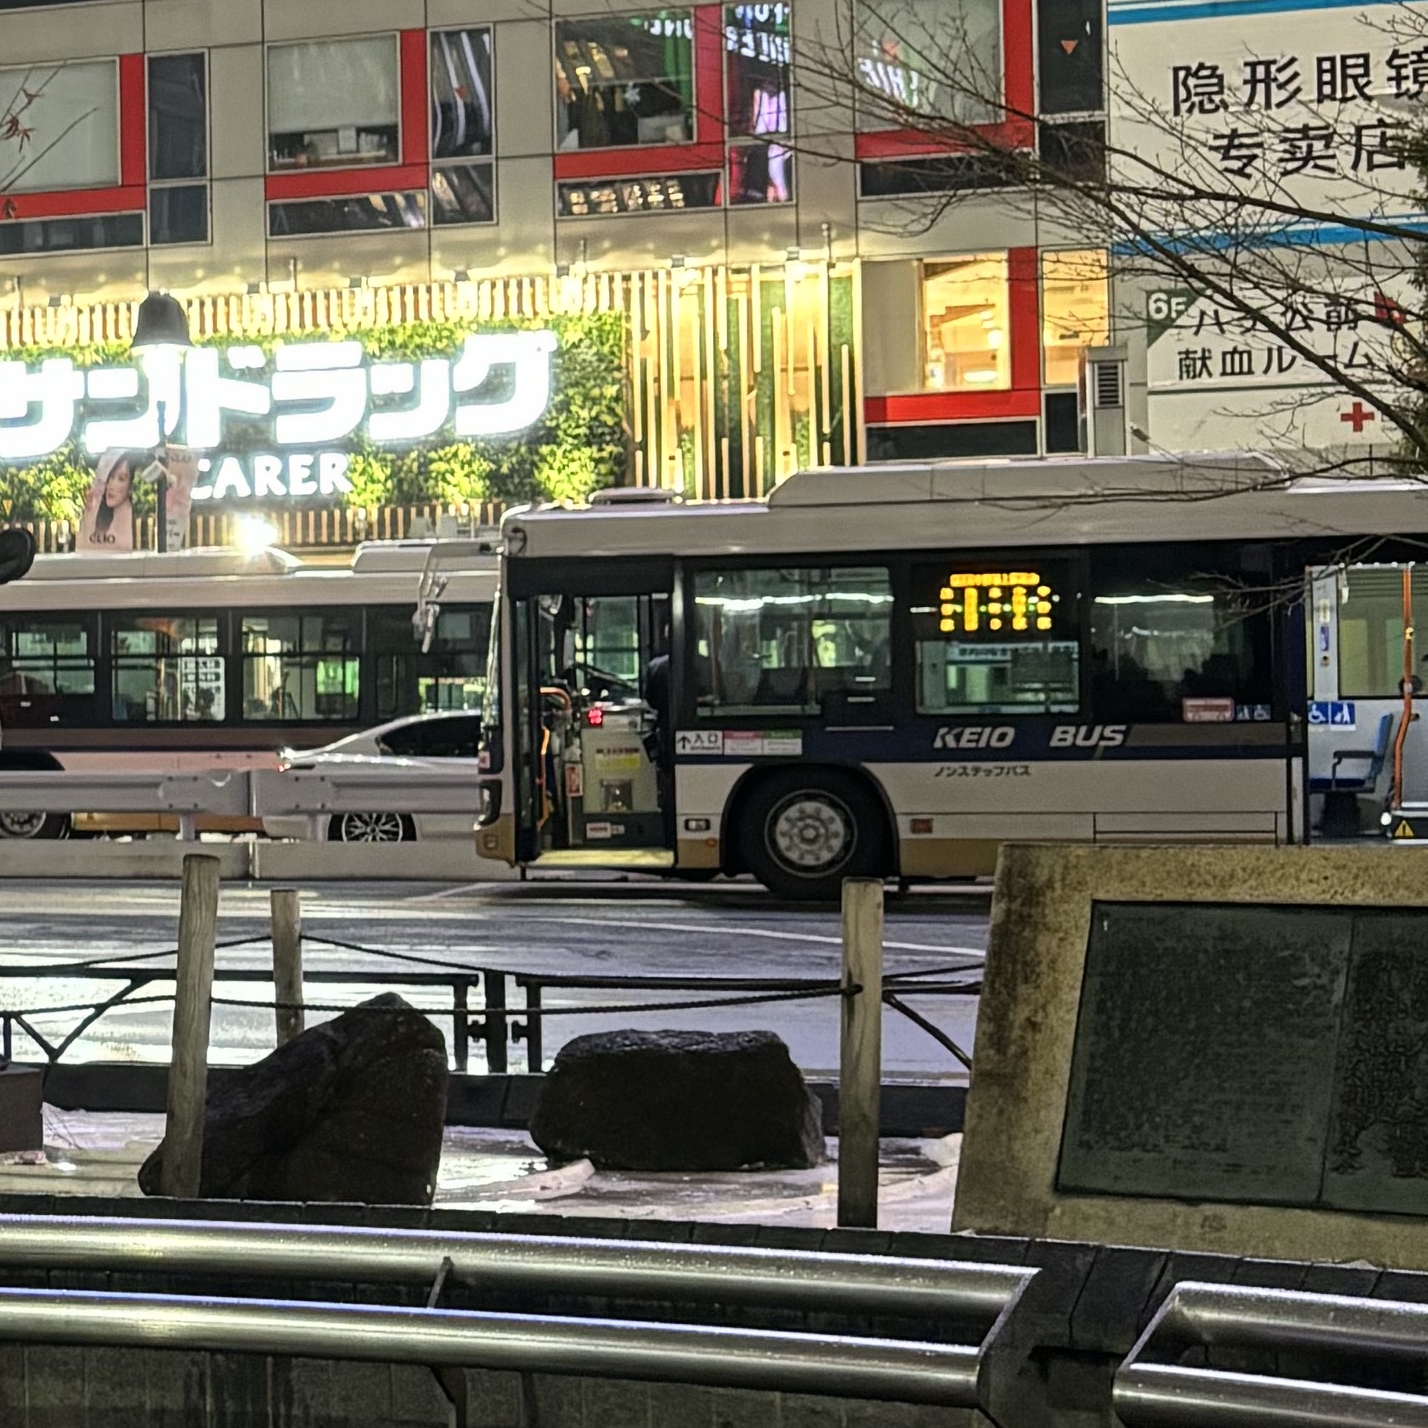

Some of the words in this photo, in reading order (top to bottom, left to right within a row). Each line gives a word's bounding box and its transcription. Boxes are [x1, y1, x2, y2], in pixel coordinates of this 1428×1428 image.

[1209, 118, 1408, 180] 专卖店
[1148, 292, 1188, 321] 6F
[933, 726, 1016, 749] KEIO
[1049, 724, 1129, 748] BUS
[934, 764, 1032, 778] ノンステップバス
